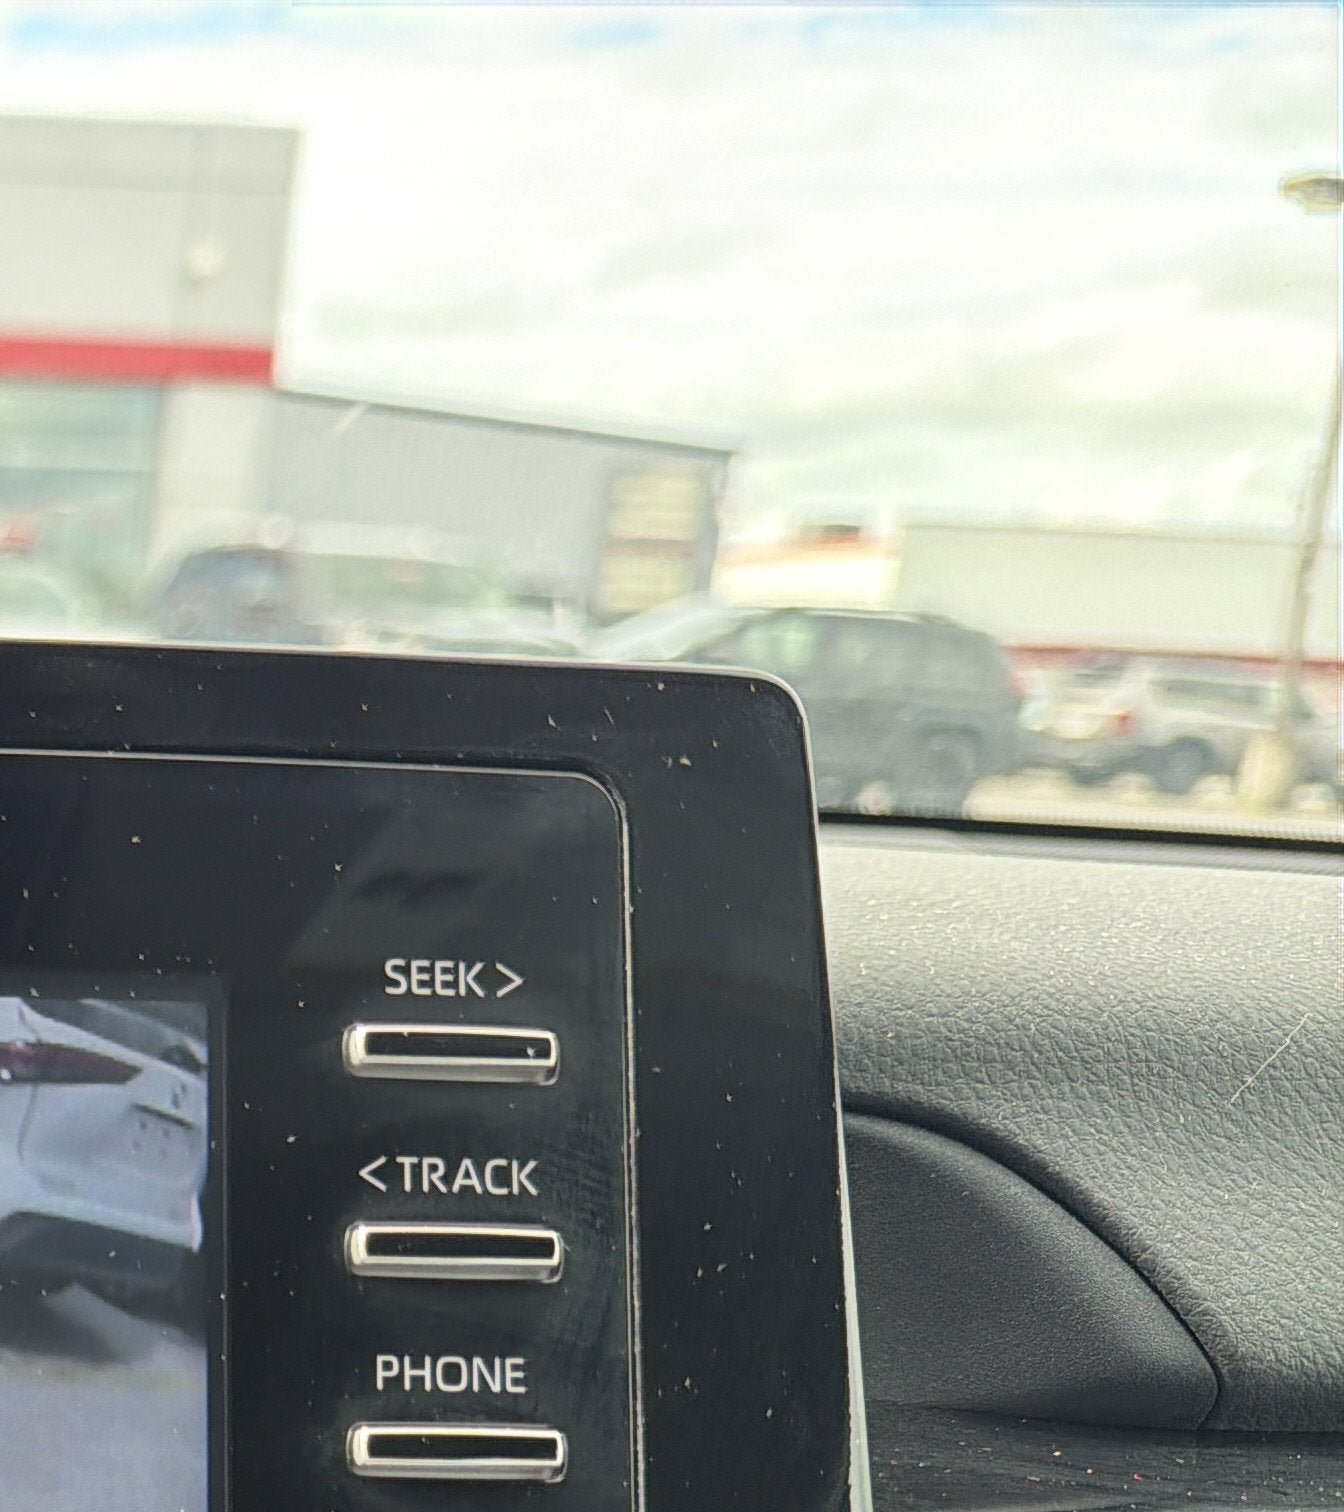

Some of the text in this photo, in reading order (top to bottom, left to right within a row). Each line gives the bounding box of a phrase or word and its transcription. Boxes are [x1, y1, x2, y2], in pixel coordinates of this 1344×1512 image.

[384, 958, 486, 998] SEEK
[396, 1156, 539, 1196] TRACK
[376, 1354, 528, 1394] PHONE
